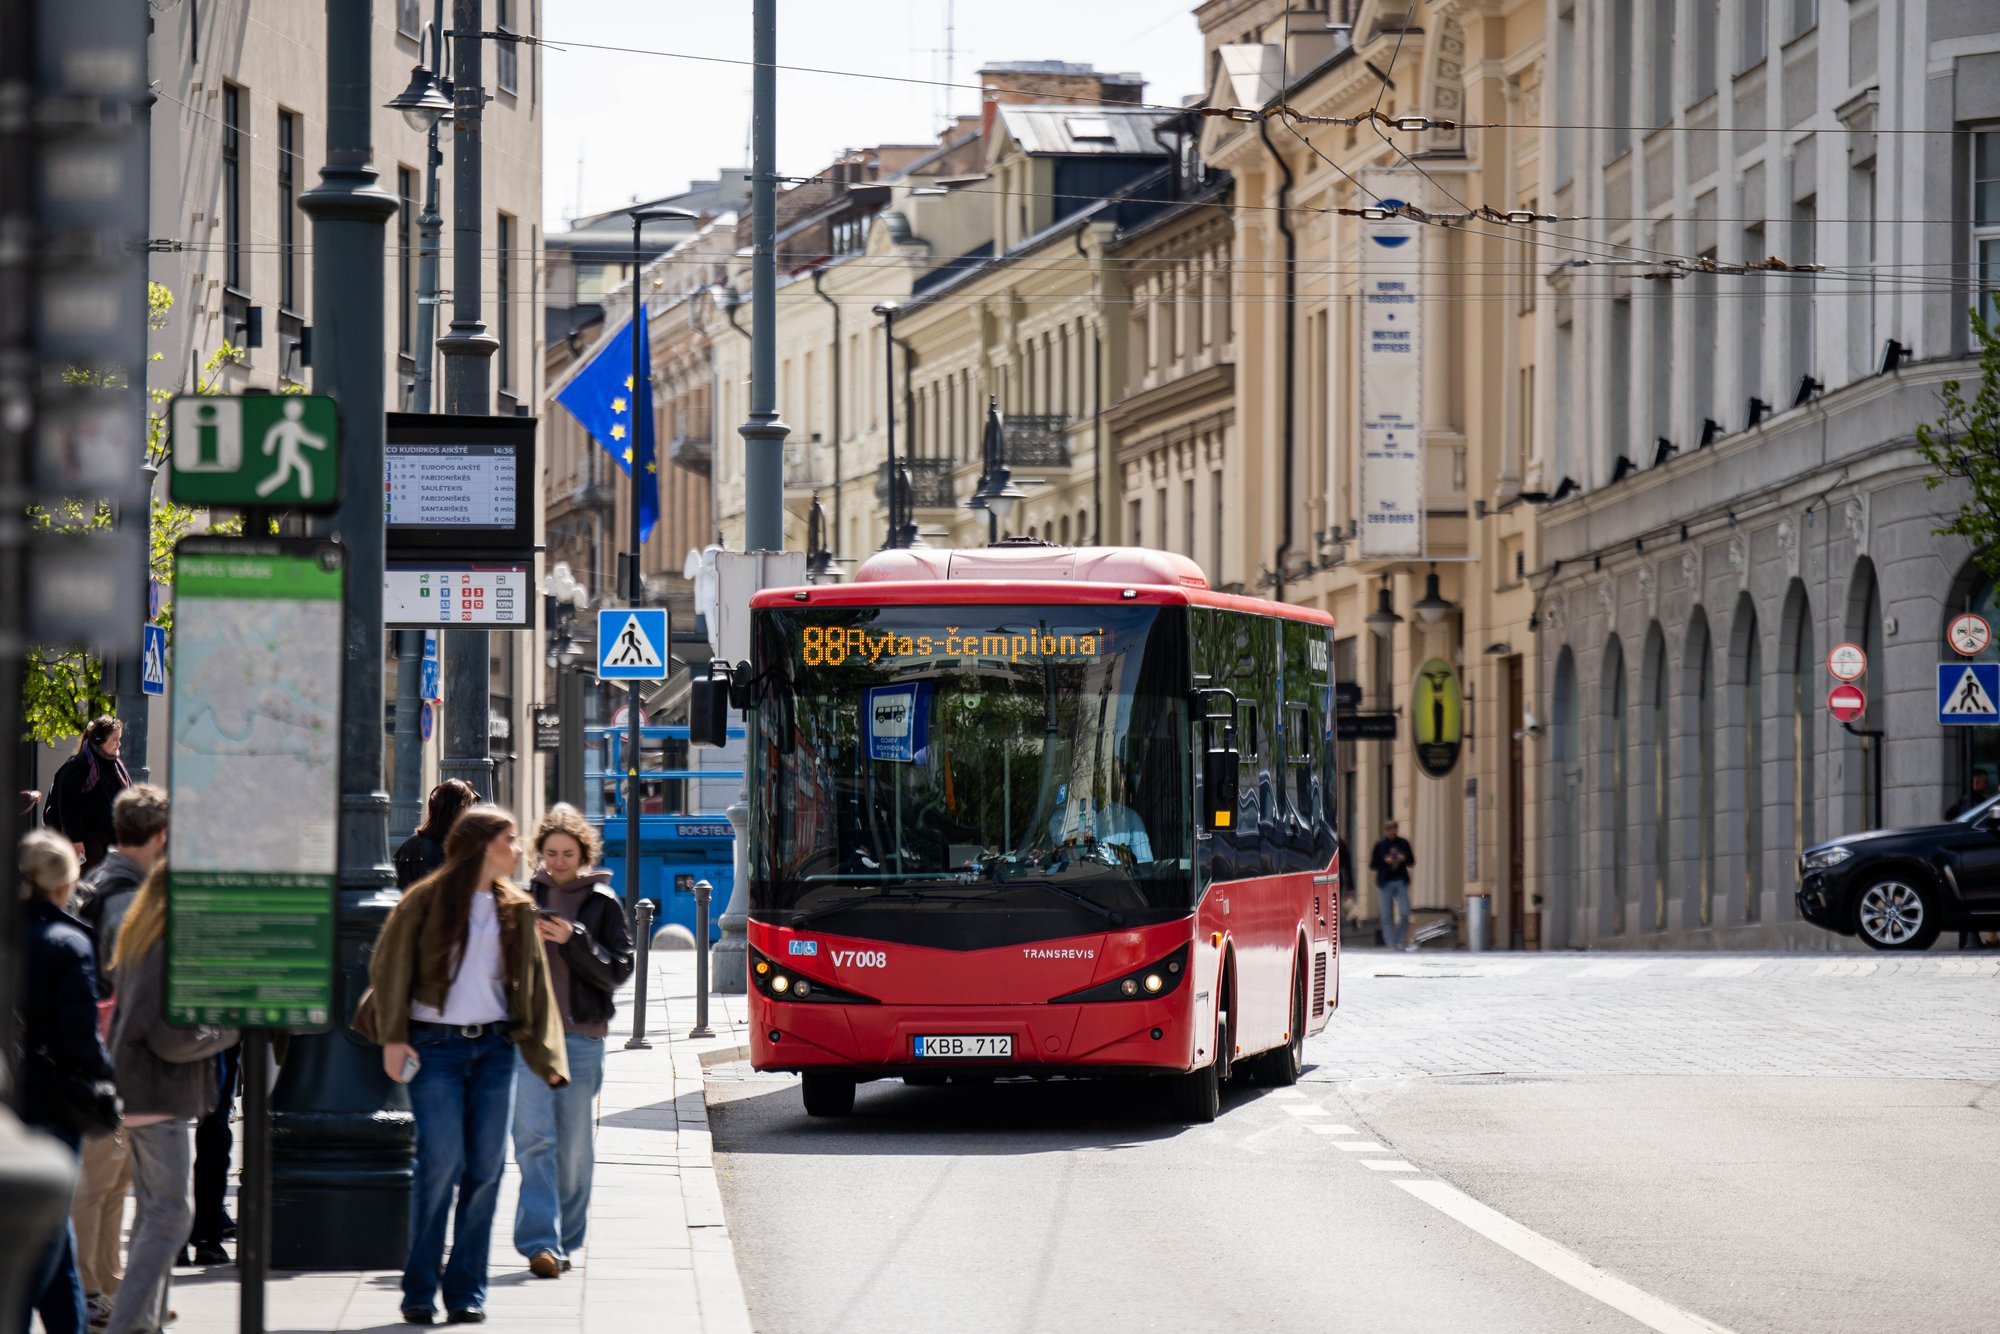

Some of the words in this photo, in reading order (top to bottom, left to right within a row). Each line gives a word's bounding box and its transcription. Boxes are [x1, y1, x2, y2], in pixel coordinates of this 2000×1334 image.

[1372, 344, 1411, 352] OFFICES
[442, 446, 468, 454] AIKŠTĖ
[803, 627, 846, 666] 88
[831, 950, 886, 968] V7008
[1023, 950, 1094, 958] TRANSREVIS
[926, 1039, 963, 1054] KBB
[976, 1039, 1008, 1054] 712
